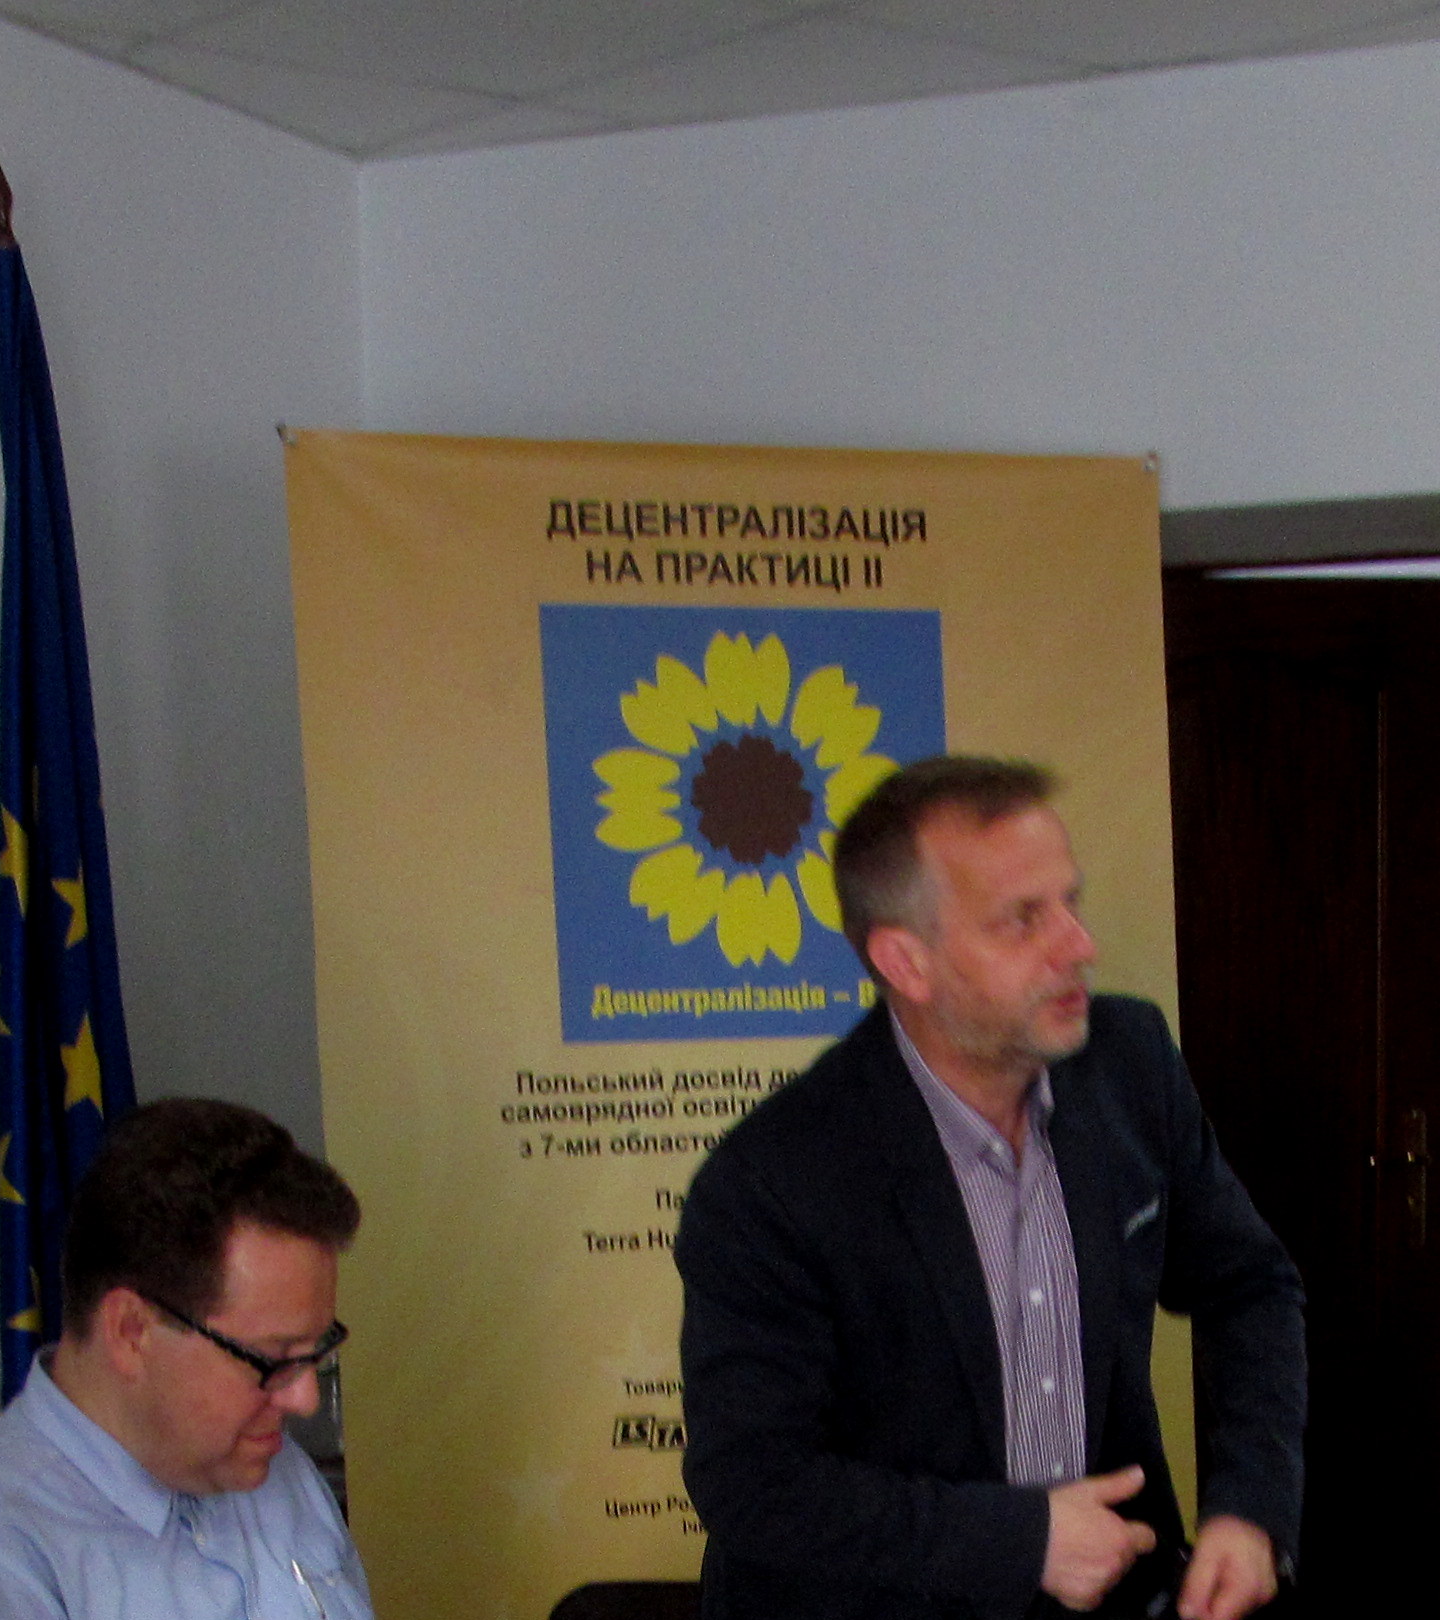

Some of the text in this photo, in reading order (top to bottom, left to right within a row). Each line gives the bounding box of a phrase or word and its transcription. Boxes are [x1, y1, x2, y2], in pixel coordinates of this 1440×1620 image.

[547, 500, 927, 547] ДЕЦЕНТРАЛІЗАЦІЯ
[585, 549, 643, 584] НА
[655, 550, 850, 593] ПРАКТИЦІ
[591, 981, 826, 1020] Децентралізація
[516, 1068, 664, 1098] Польський
[671, 1066, 761, 1097] досвід
[501, 1096, 675, 1126] самоврядної
[541, 1133, 602, 1159] 7-ми
[582, 1230, 641, 1253] Terra
[604, 1499, 661, 1518] Центр
